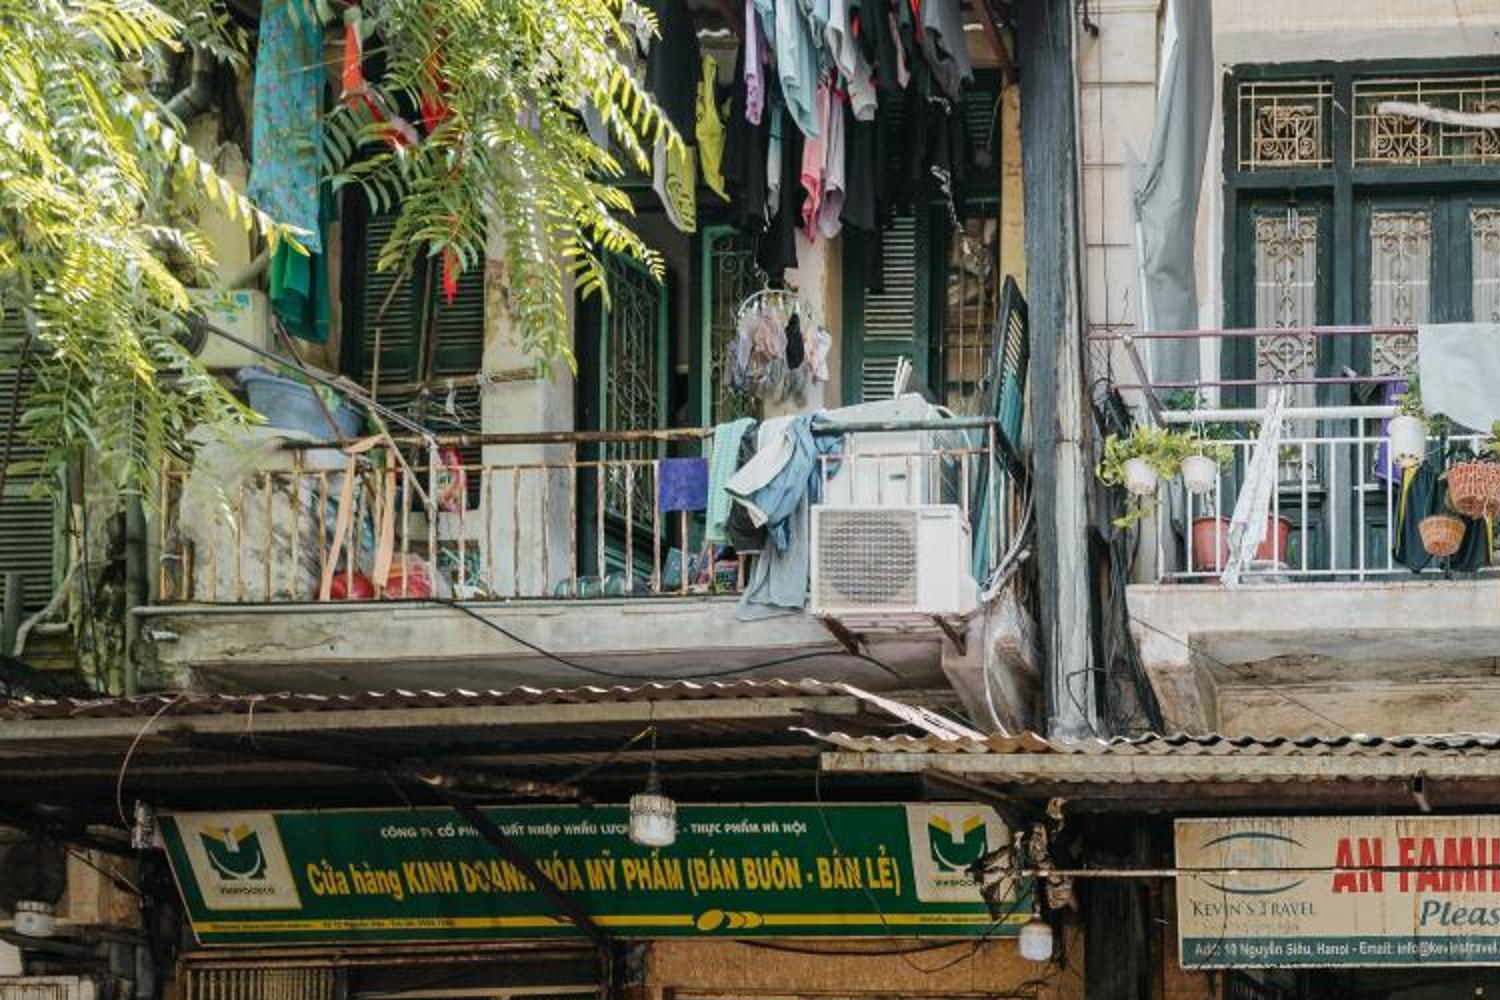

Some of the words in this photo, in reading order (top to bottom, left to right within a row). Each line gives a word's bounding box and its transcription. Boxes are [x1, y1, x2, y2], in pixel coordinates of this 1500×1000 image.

[307, 857, 351, 896] Cửa
[348, 861, 405, 902] hàng
[402, 860, 460, 895] KINH
[585, 849, 617, 892] MỸ
[621, 848, 685, 891] PHẨM
[687, 848, 740, 897] (BÁN
[741, 849, 803, 891] BUÔN
[815, 847, 863, 889] BÁN
[865, 843, 901, 897] LẺ)
[1332, 837, 1384, 893] AN
[1358, 941, 1395, 956] Email:
